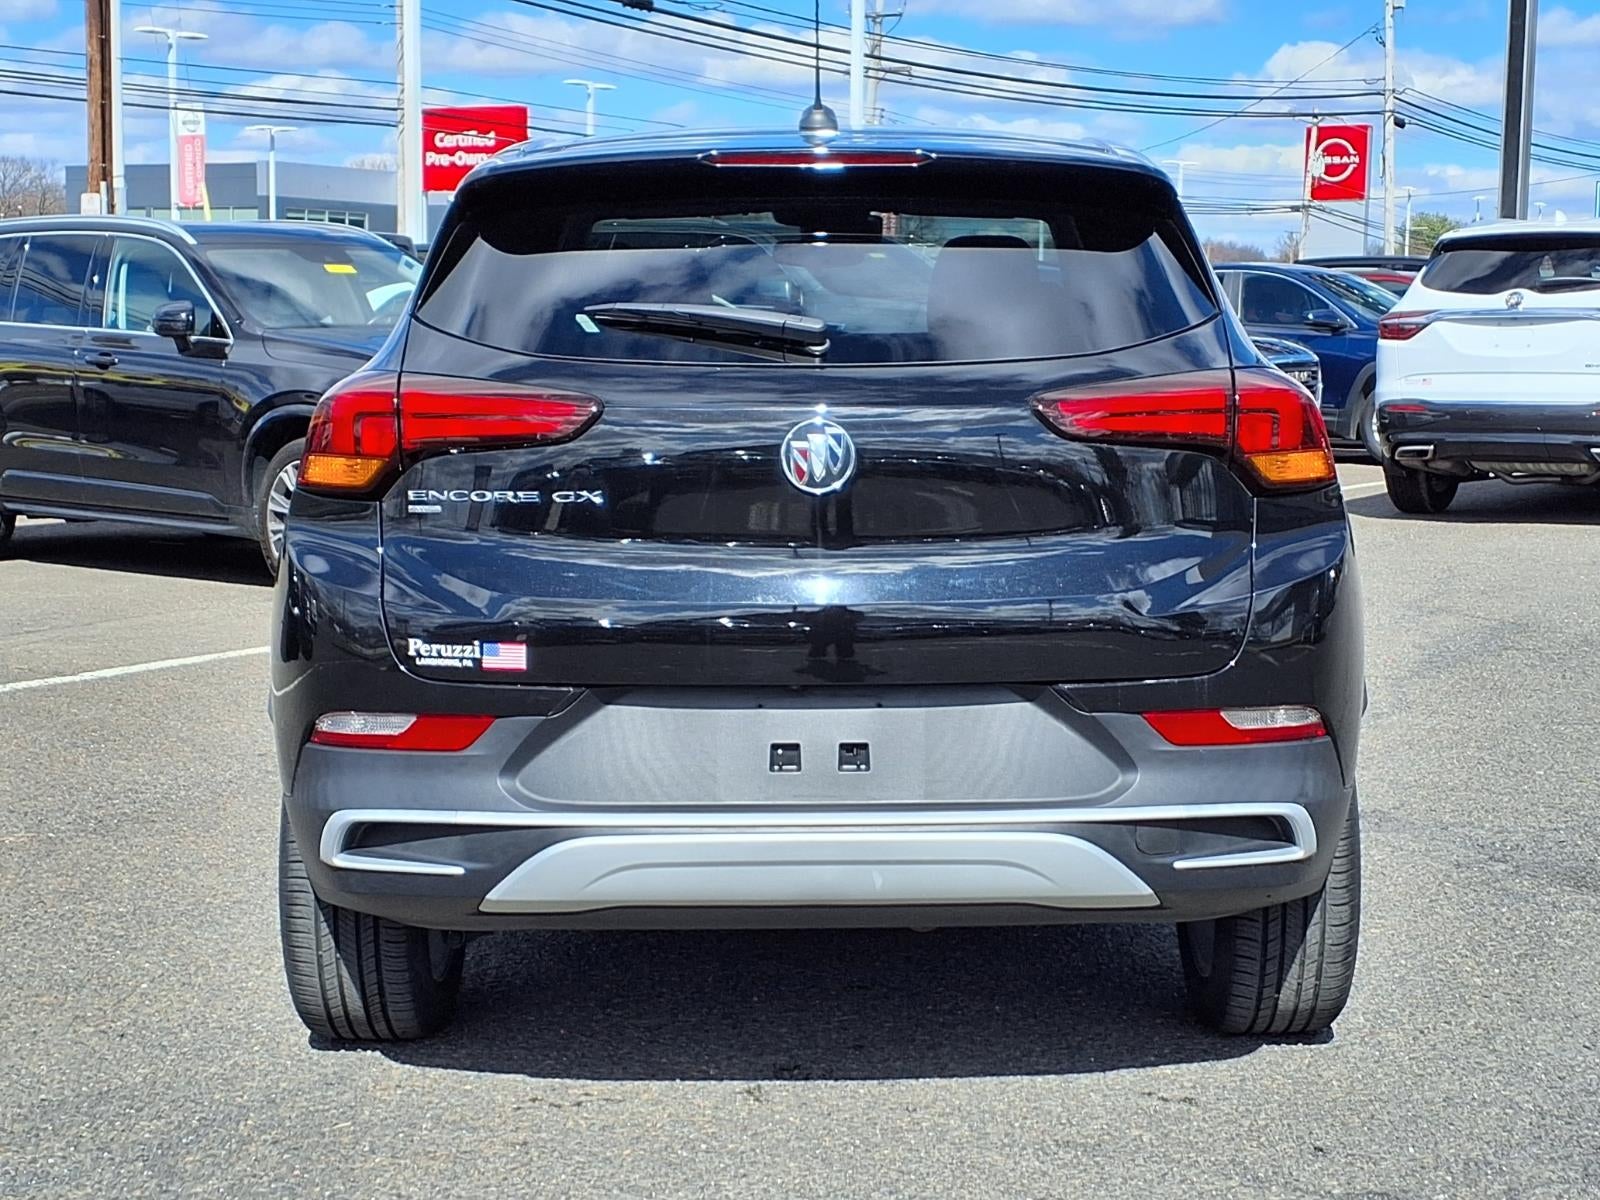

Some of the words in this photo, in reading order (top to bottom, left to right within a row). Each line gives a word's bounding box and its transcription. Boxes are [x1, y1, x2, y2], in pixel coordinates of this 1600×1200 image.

[434, 130, 496, 148] Certified
[407, 489, 540, 504] ENCORE
[552, 489, 605, 505] GX
[407, 638, 481, 659] Peruzzi
